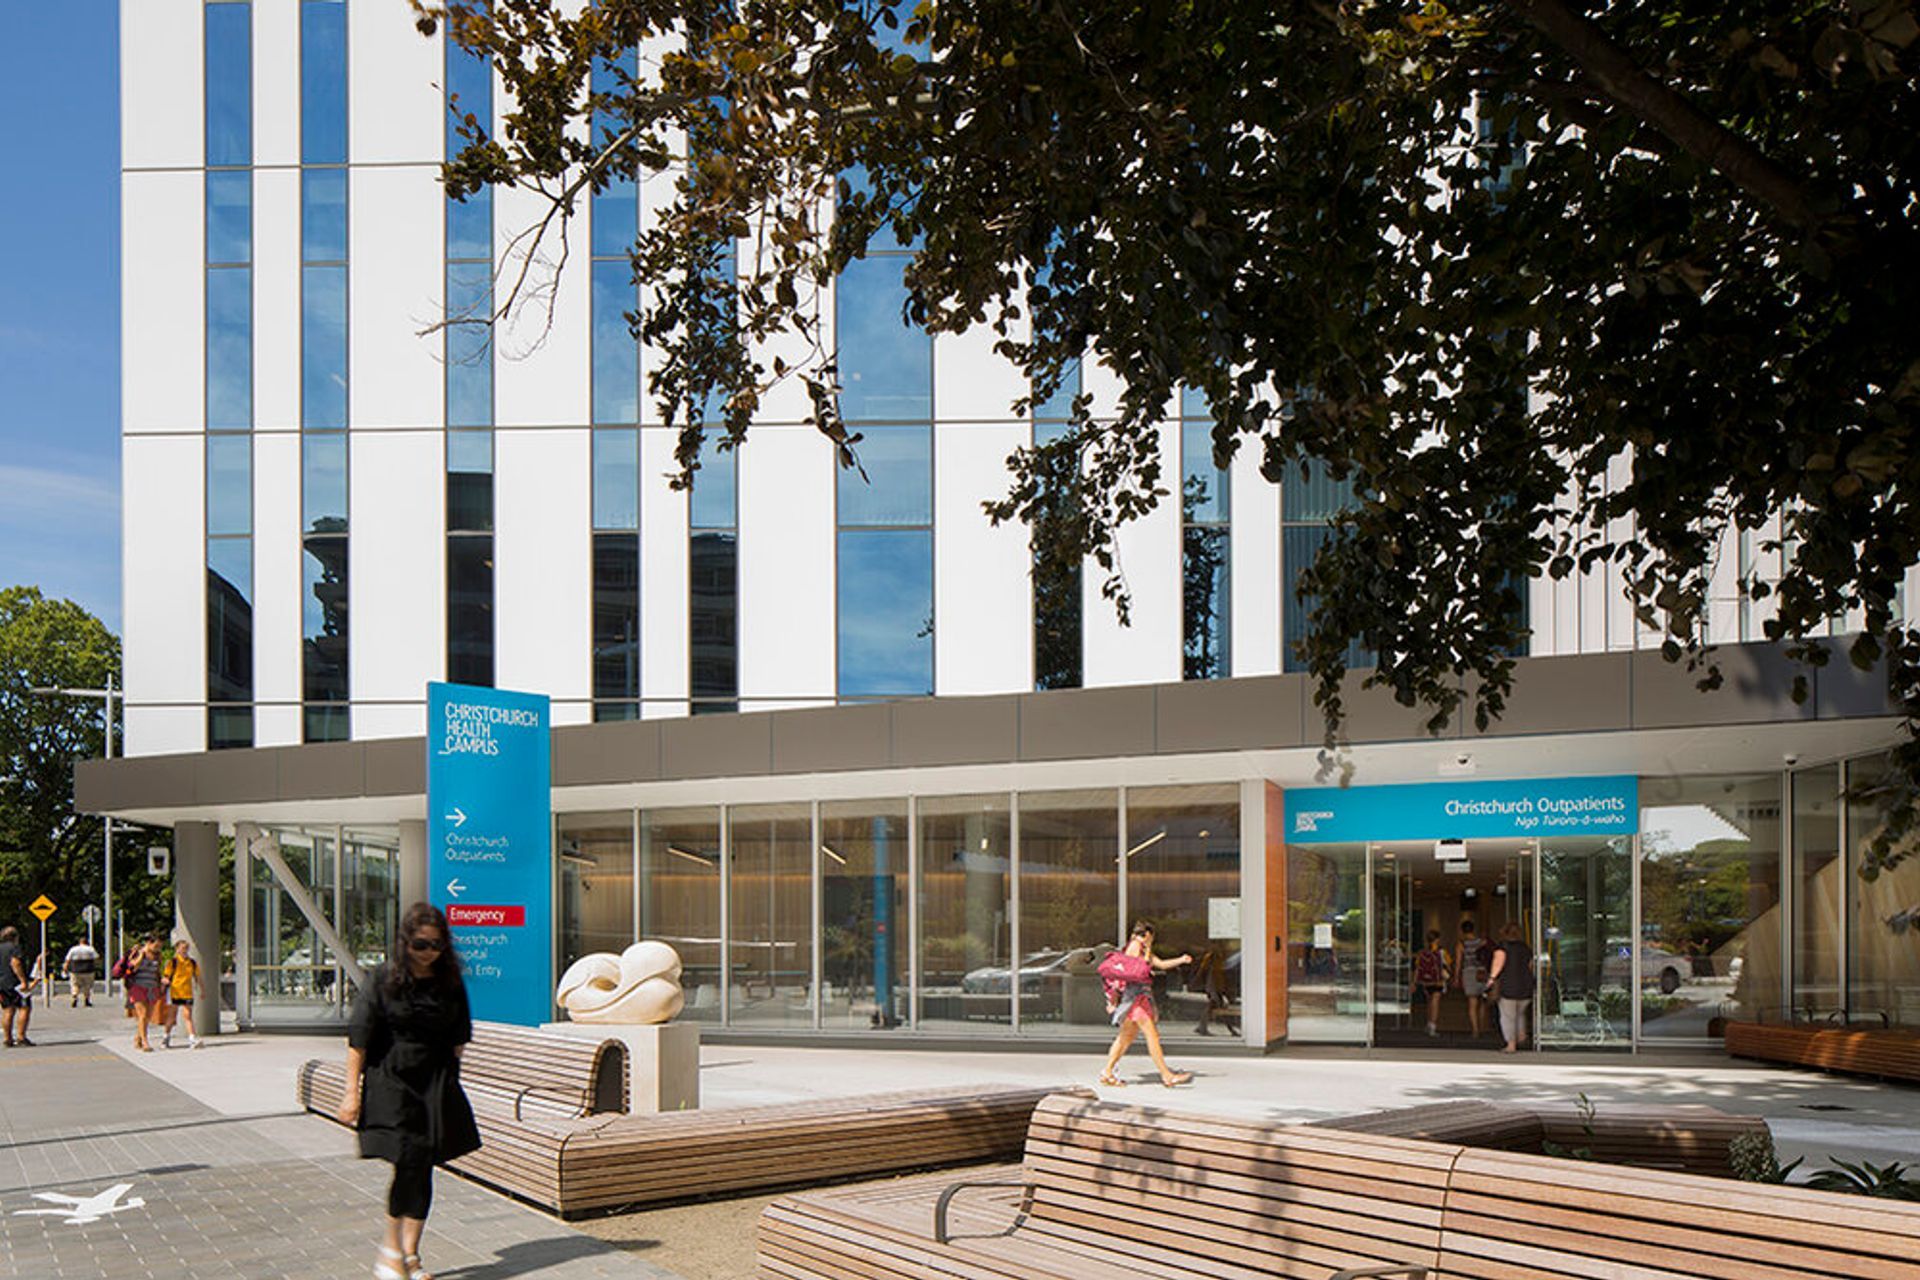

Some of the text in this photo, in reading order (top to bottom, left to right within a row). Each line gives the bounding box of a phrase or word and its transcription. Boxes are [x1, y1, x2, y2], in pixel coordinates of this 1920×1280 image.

[445, 701, 539, 727] CHRISTCHURCH
[446, 719, 490, 738] HEALTH
[440, 735, 499, 756] CAMPUS
[1444, 795, 1626, 816] Christchurch Outpatients
[450, 906, 506, 924] Emergency
[475, 963, 502, 979] Entry
